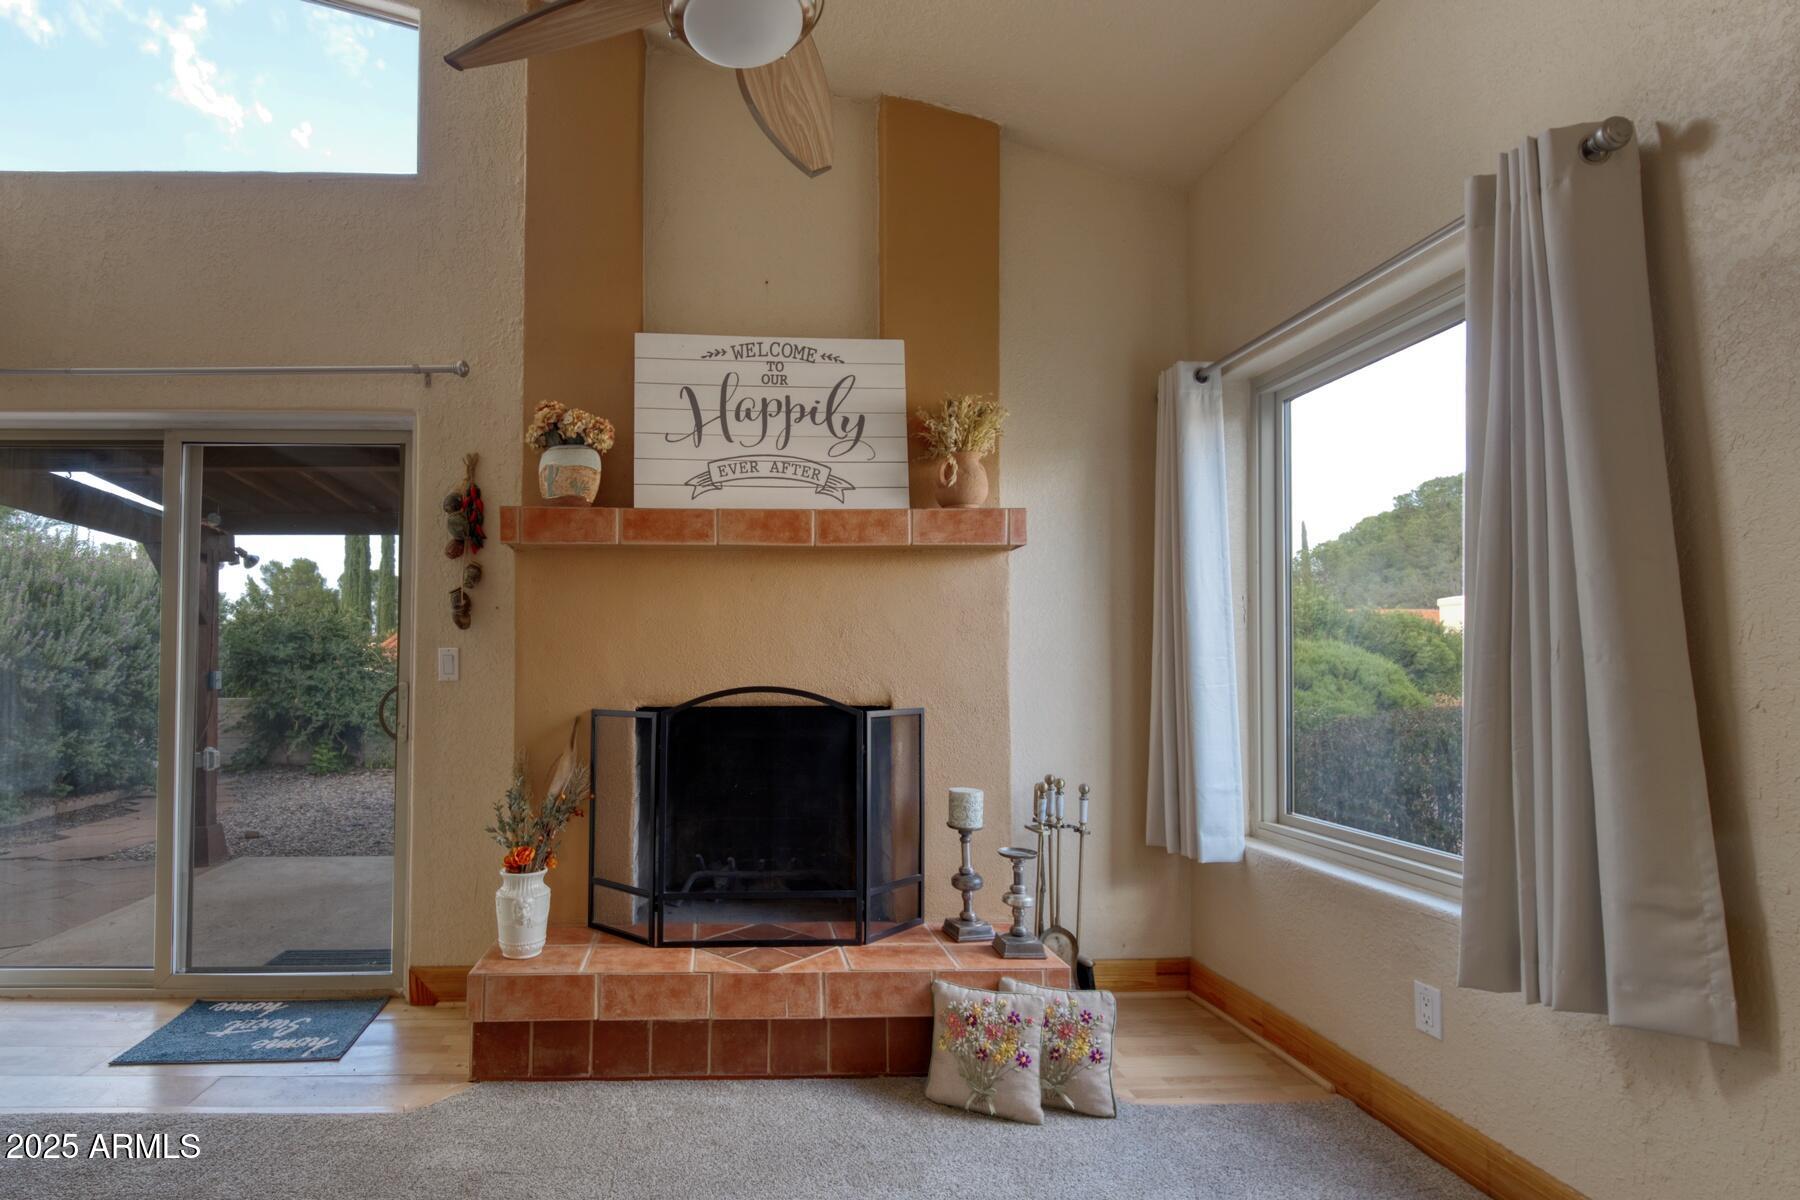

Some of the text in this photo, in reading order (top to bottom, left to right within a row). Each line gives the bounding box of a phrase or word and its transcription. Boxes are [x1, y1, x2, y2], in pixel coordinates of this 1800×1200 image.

[730, 342, 818, 364] WELCOME
[766, 361, 784, 372] TO
[761, 374, 789, 386] OUR
[665, 372, 876, 461] Happily
[717, 460, 822, 482] EVER AFTER
